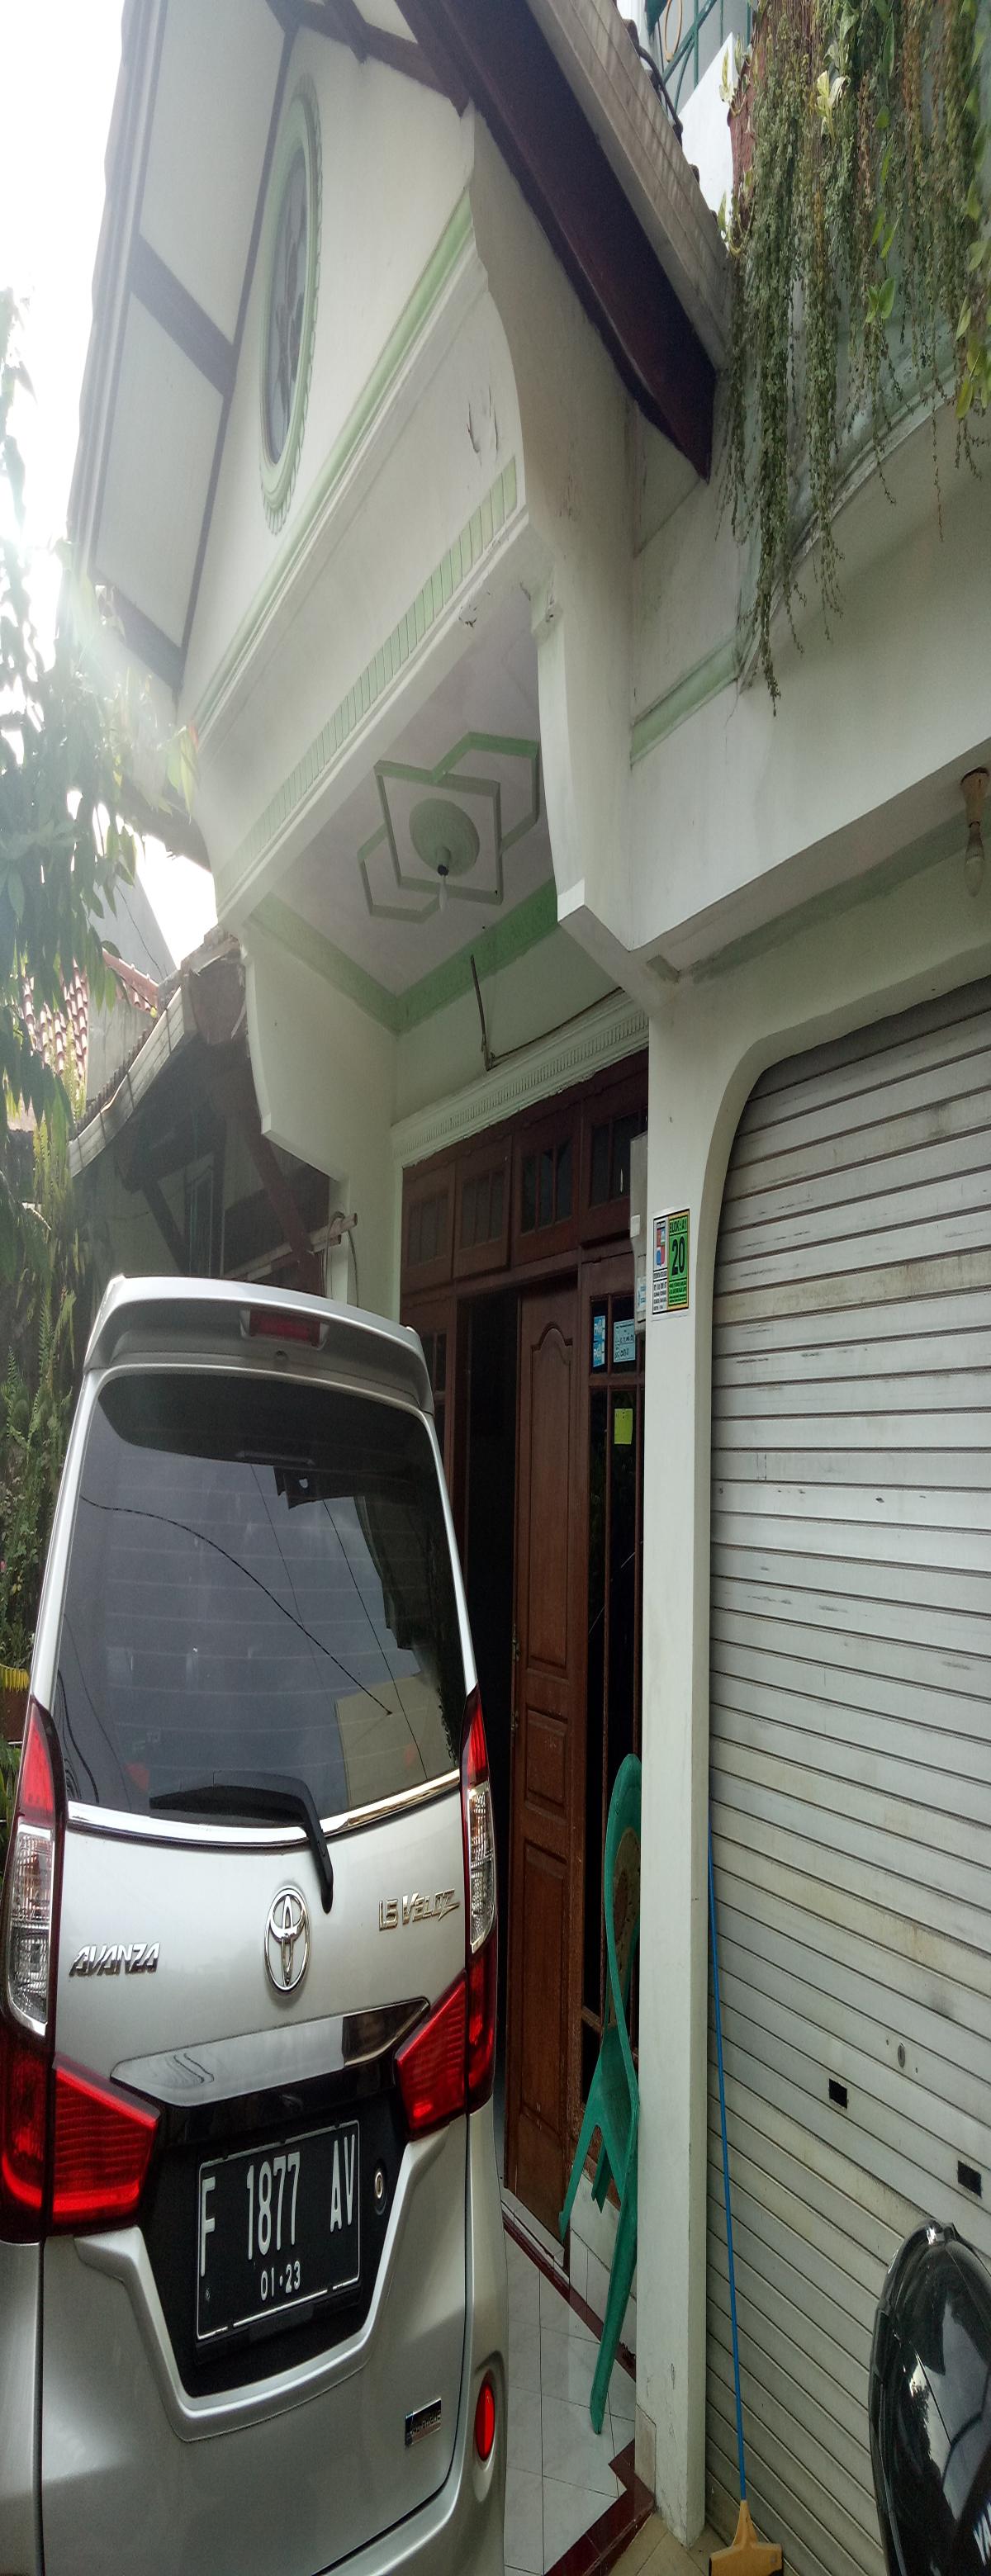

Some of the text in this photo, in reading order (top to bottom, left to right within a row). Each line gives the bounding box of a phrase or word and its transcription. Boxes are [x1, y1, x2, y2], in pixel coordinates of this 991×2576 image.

[671, 1236, 685, 1276] 20
[69, 1942, 160, 1977] AVANZA
[201, 2134, 355, 2277] F 1877 AV
